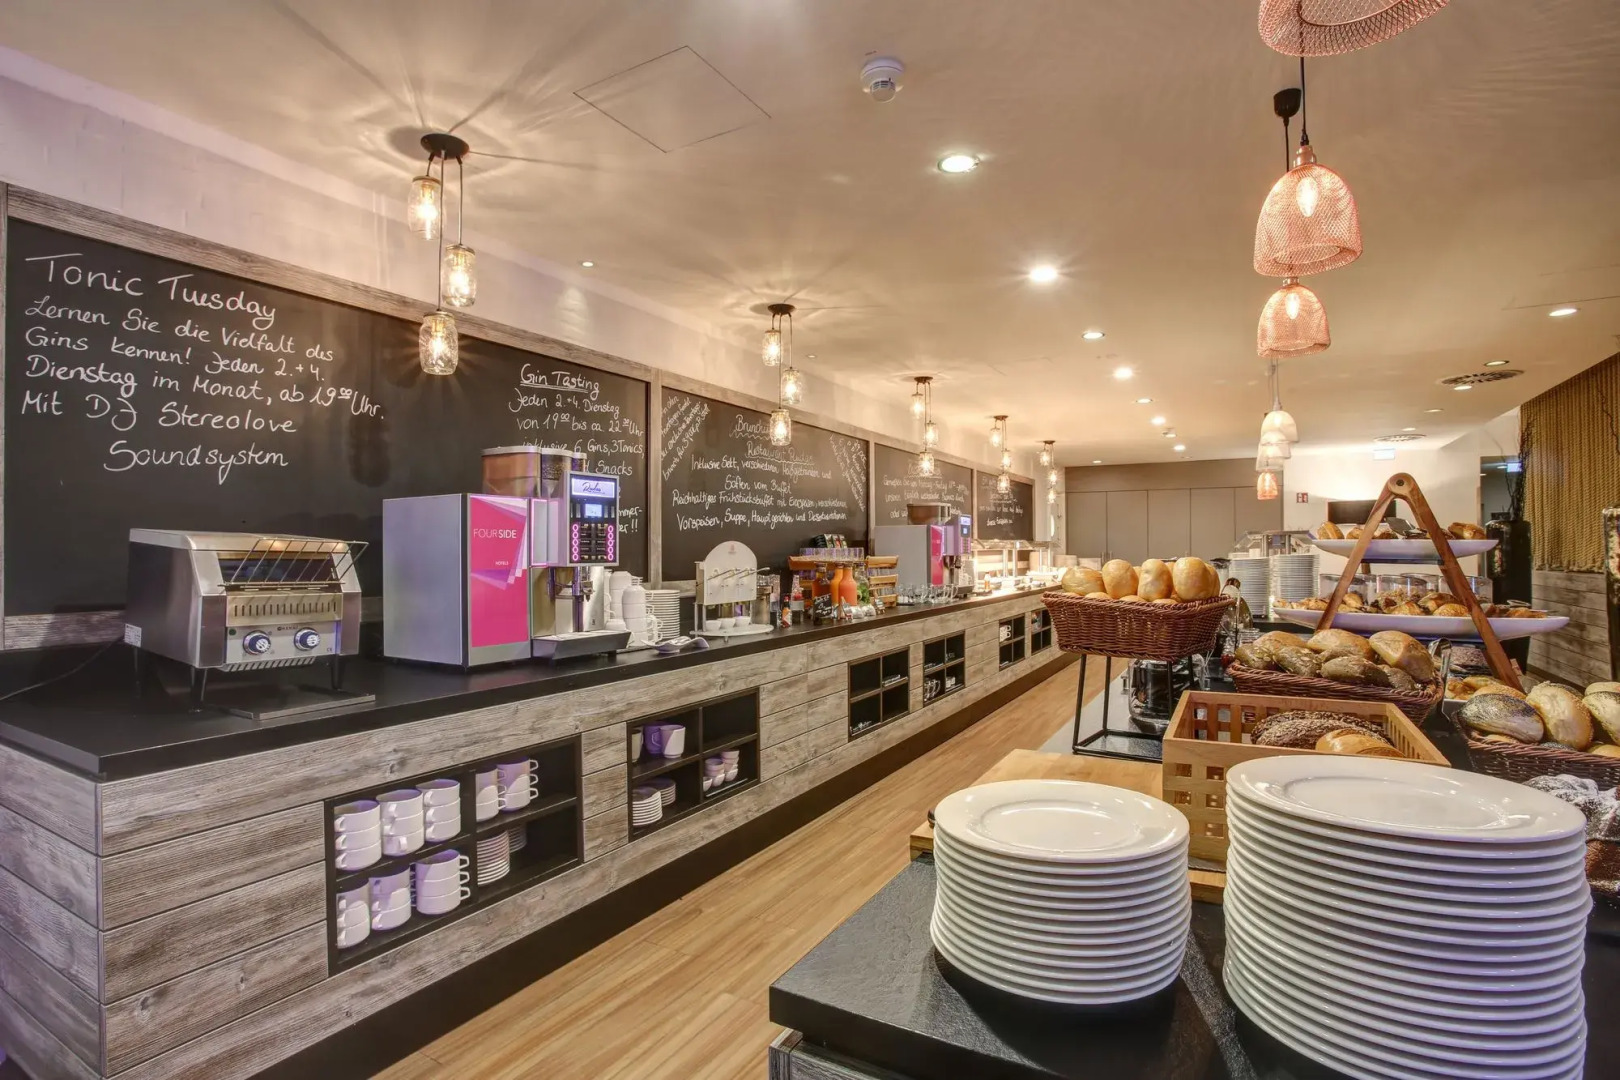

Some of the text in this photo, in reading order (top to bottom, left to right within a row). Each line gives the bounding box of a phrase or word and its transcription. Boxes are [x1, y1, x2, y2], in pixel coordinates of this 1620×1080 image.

[25, 253, 276, 330] Tonic Tuesday
[25, 296, 334, 362] Lernen Sie die Vielfalt des
[25, 327, 89, 350] Gins
[111, 339, 191, 365] kennen!
[205, 352, 264, 374] Jeden
[26, 354, 137, 397] Dienstag
[153, 371, 180, 392] im
[193, 375, 273, 405] Monat,
[280, 380, 304, 403] ab
[520, 363, 600, 400] Gin Tasting
[21, 390, 63, 416] Mit
[159, 402, 297, 434] Stereolove
[508, 388, 548, 413] Jeden
[583, 399, 620, 420] Dienstag
[517, 418, 540, 431] von
[571, 416, 587, 431] bis
[629, 420, 645, 437] Uhr
[103, 440, 289, 485] Soundsystem
[596, 460, 633, 476] Snacks
[672, 489, 717, 510] Reichhaltiges
[719, 491, 775, 507] Frühstücksbuffet
[753, 481, 768, 491] vom
[770, 479, 792, 496] Buffet
[676, 513, 723, 531] Vorspeisen,
[724, 507, 750, 528] Suppe,
[796, 512, 806, 521] und
